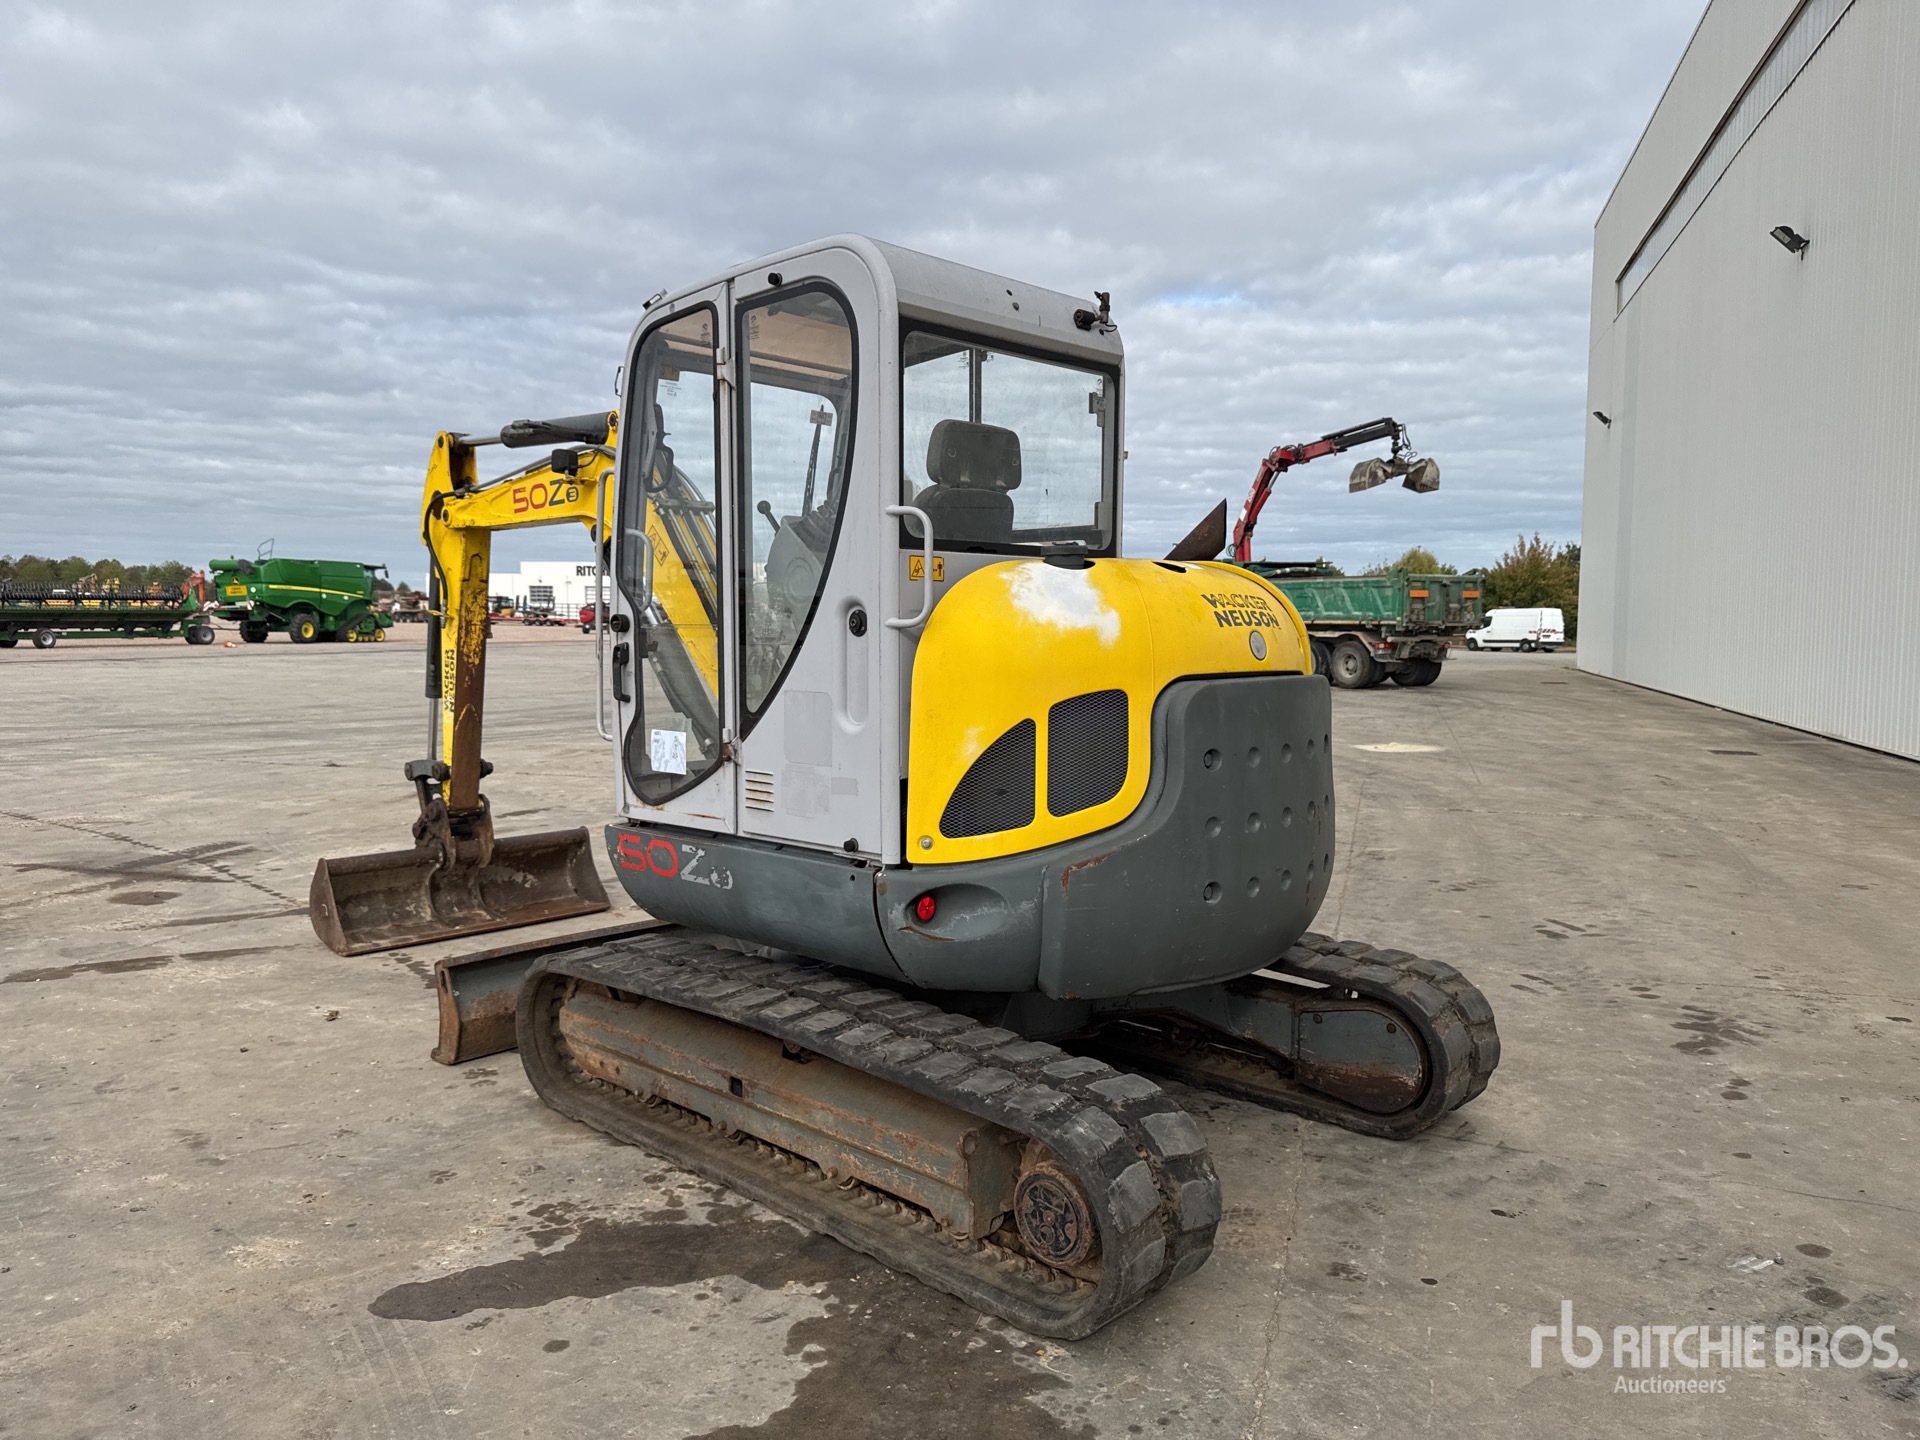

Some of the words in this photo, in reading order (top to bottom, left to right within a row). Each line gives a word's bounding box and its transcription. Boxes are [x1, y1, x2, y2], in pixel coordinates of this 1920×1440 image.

[576, 565, 609, 577] RITC
[1201, 593, 1272, 611] WACKER
[1214, 610, 1280, 629] NEUSON
